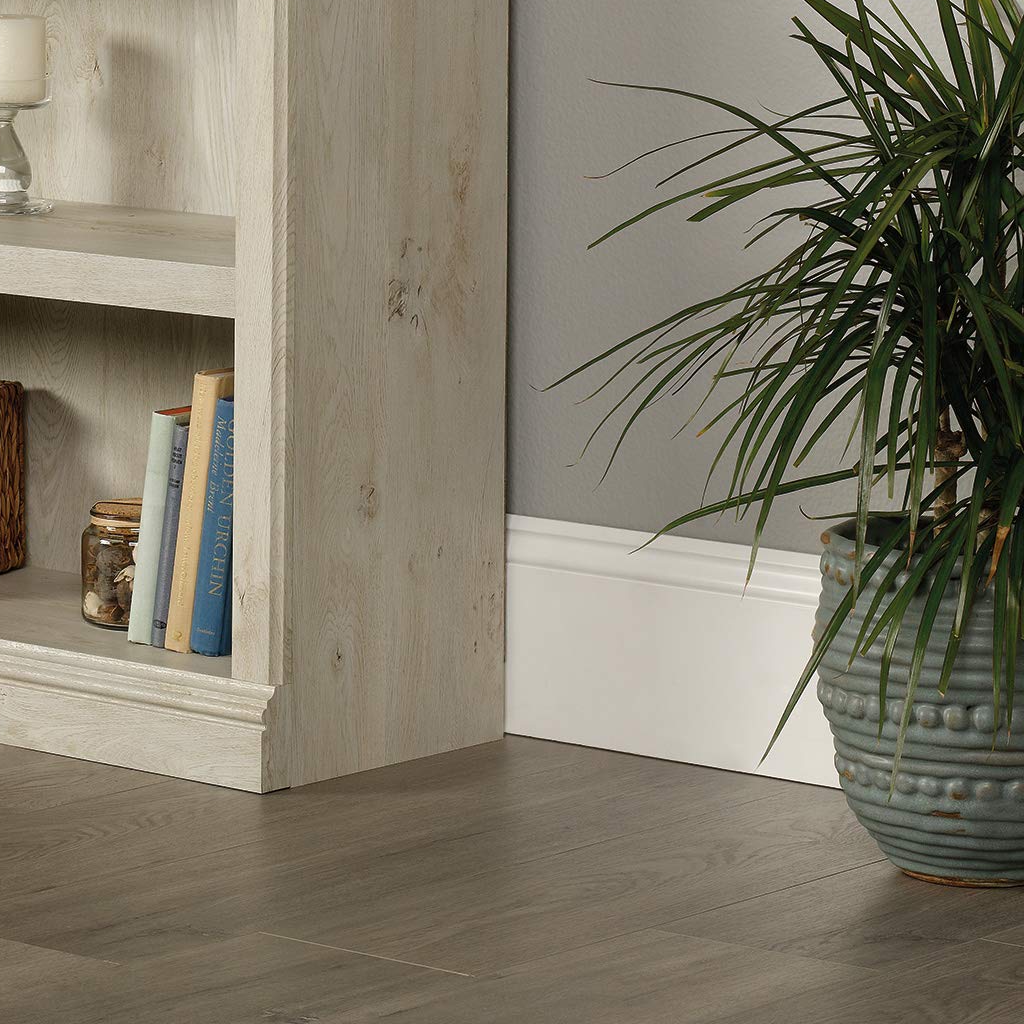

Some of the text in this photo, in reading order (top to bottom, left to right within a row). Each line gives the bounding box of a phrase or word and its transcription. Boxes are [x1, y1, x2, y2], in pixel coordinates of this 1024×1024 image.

[207, 416, 227, 513] Madeleine Brent
[208, 515, 232, 597] URCHIN
